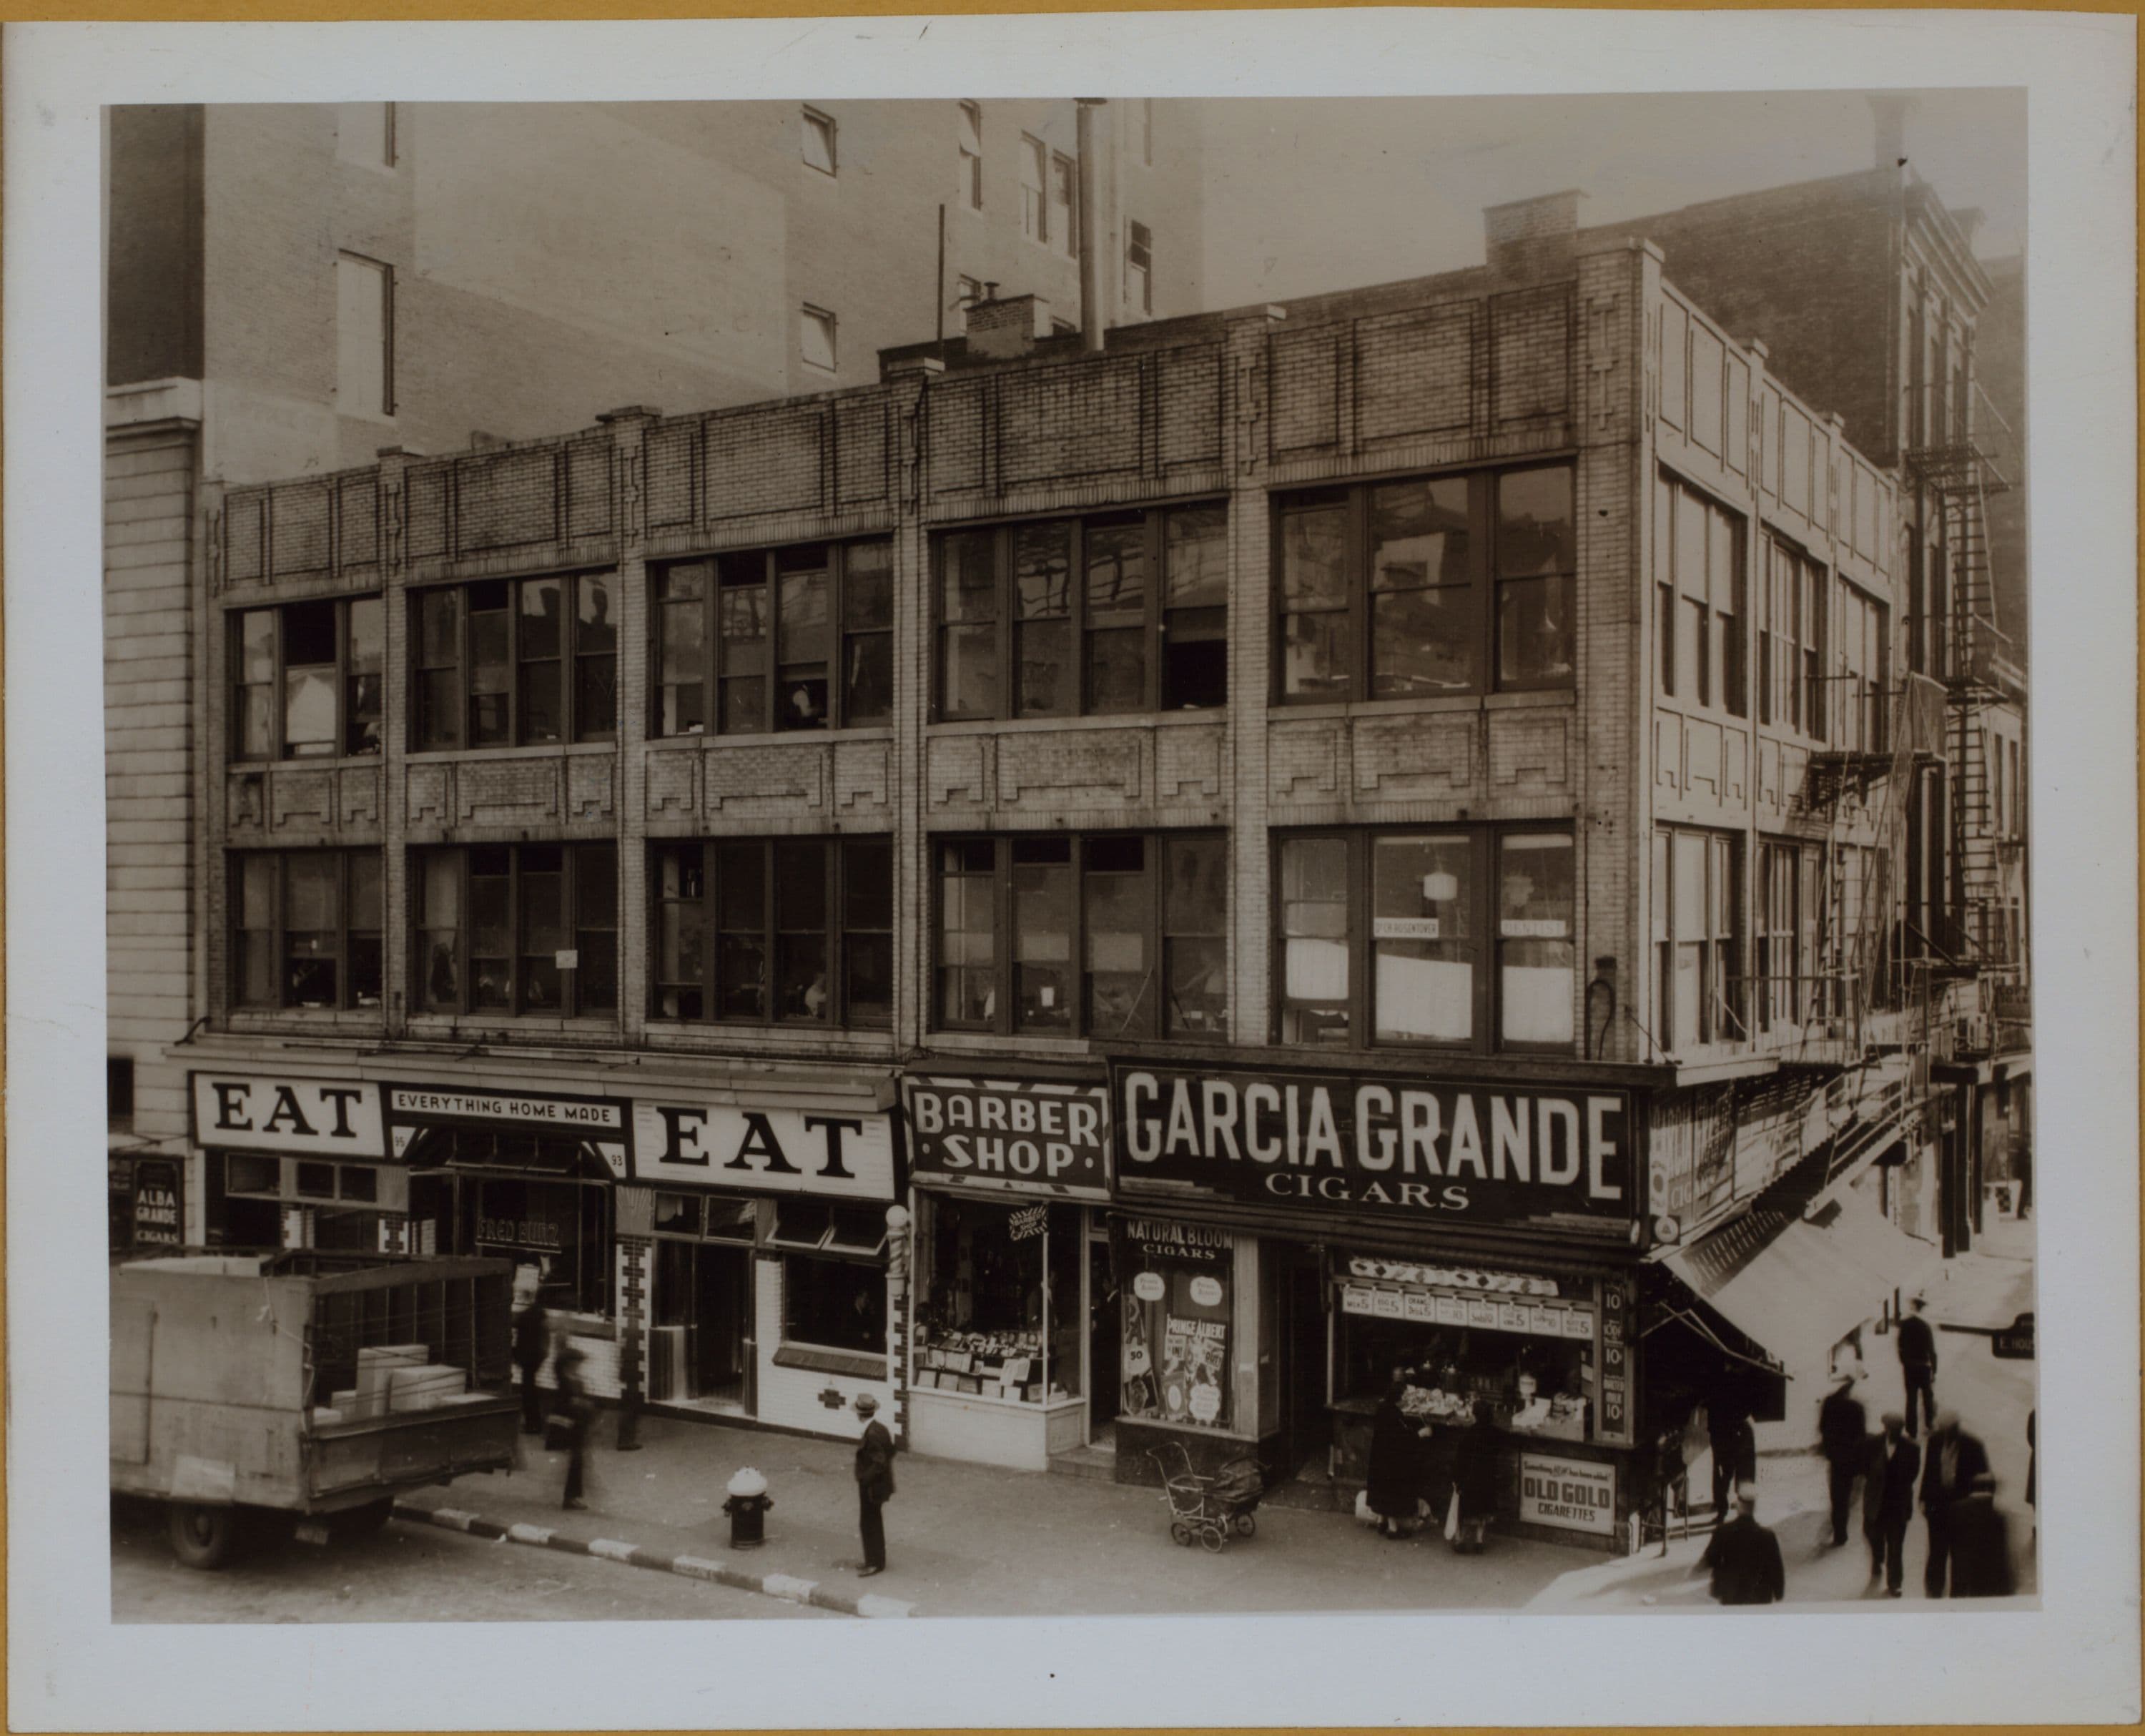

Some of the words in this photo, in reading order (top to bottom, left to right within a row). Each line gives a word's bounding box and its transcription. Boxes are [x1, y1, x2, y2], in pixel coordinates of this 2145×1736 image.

[212, 1082, 362, 1138] EAT
[398, 1094, 502, 1113] EVERYTHING
[509, 1102, 556, 1118] HOME
[564, 1107, 610, 1122] MADE
[914, 1092, 1100, 1148] BARBER
[656, 1106, 863, 1180] EAT
[1125, 1072, 1344, 1168] GARCIA
[1355, 1085, 1622, 1200] GRANDE
[612, 1155, 623, 1166] 93
[942, 1134, 1075, 1177] SHOP
[137, 1188, 175, 1207] ALBA
[1265, 1173, 1471, 1210] CIGARS
[1127, 1218, 1185, 1245] NATURAL
[1187, 1226, 1233, 1250] BLOOM
[1143, 1243, 1216, 1260] CIGARS
[1391, 1301, 1399, 1312] 5
[1516, 1315, 1524, 1326] 5
[1167, 1313, 1197, 1336] PRINCE
[1195, 1318, 1226, 1339] ALBERT
[1580, 1321, 1589, 1333] 5
[1524, 1476, 1559, 1501] OLD
[1562, 1481, 1610, 1509] GOLD
[1537, 1501, 1595, 1522] CIGARETTES
